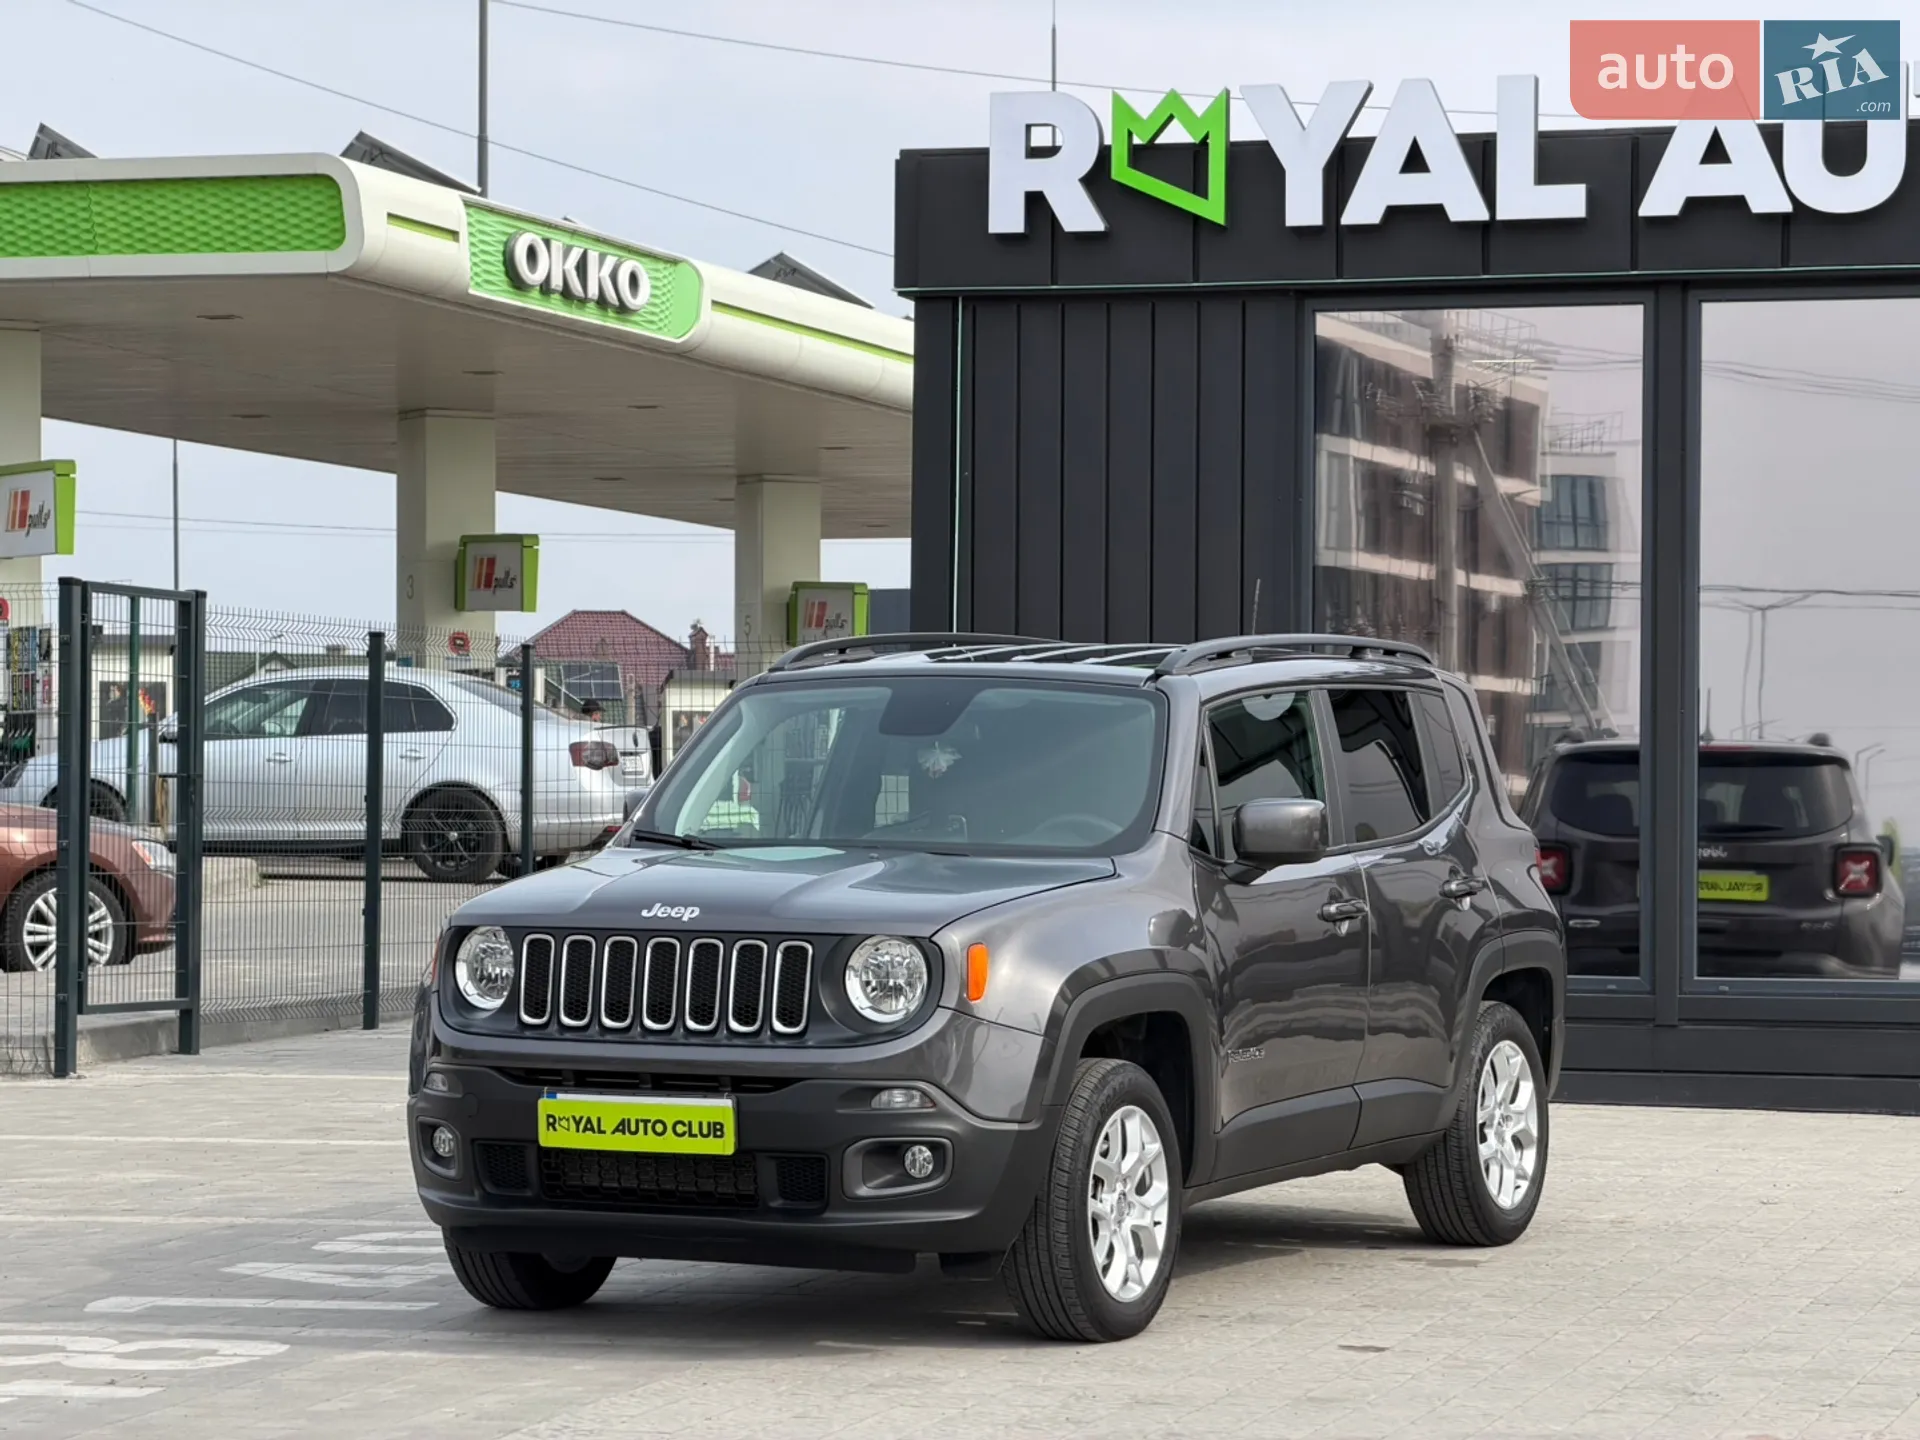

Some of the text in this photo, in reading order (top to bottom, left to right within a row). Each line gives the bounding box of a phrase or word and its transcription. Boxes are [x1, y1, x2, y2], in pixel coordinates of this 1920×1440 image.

[1637, 60, 1920, 217] AU
[506, 231, 651, 311] OKKO
[641, 902, 700, 922] Jeep
[611, 1117, 668, 1137] AUTO
[671, 1120, 725, 1139] CLUB
